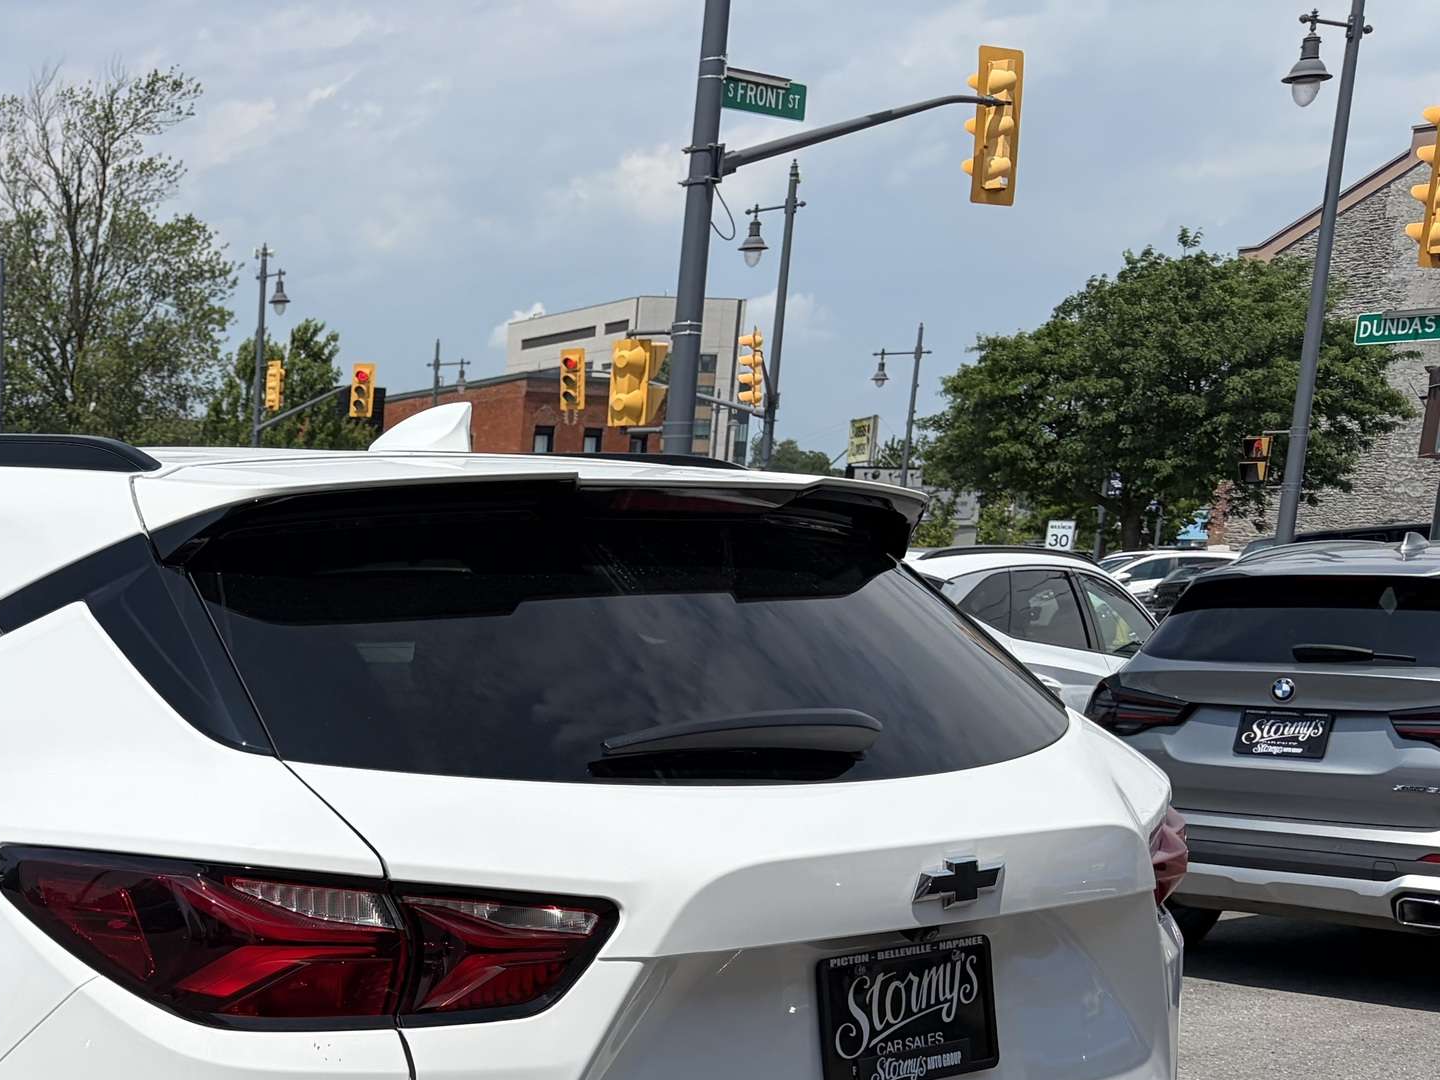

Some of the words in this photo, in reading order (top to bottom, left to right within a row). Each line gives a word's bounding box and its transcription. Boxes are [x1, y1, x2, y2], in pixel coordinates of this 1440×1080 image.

[728, 83, 734, 97] S
[737, 82, 786, 110] FRONT
[788, 94, 800, 109] ST
[1359, 316, 1436, 337] DUNDAS
[1049, 534, 1069, 547] 30
[1241, 719, 1325, 744] Stormy's
[830, 954, 869, 968] PICTON
[877, 944, 931, 961] BELLEVILLE
[938, 936, 984, 951] NAPANEE
[835, 953, 979, 1059] Stormy's
[877, 1038, 903, 1056] CAR
[905, 1031, 944, 1051] SALES
[927, 1055, 942, 1070] AUTO
[942, 1050, 962, 1068] GROUP
